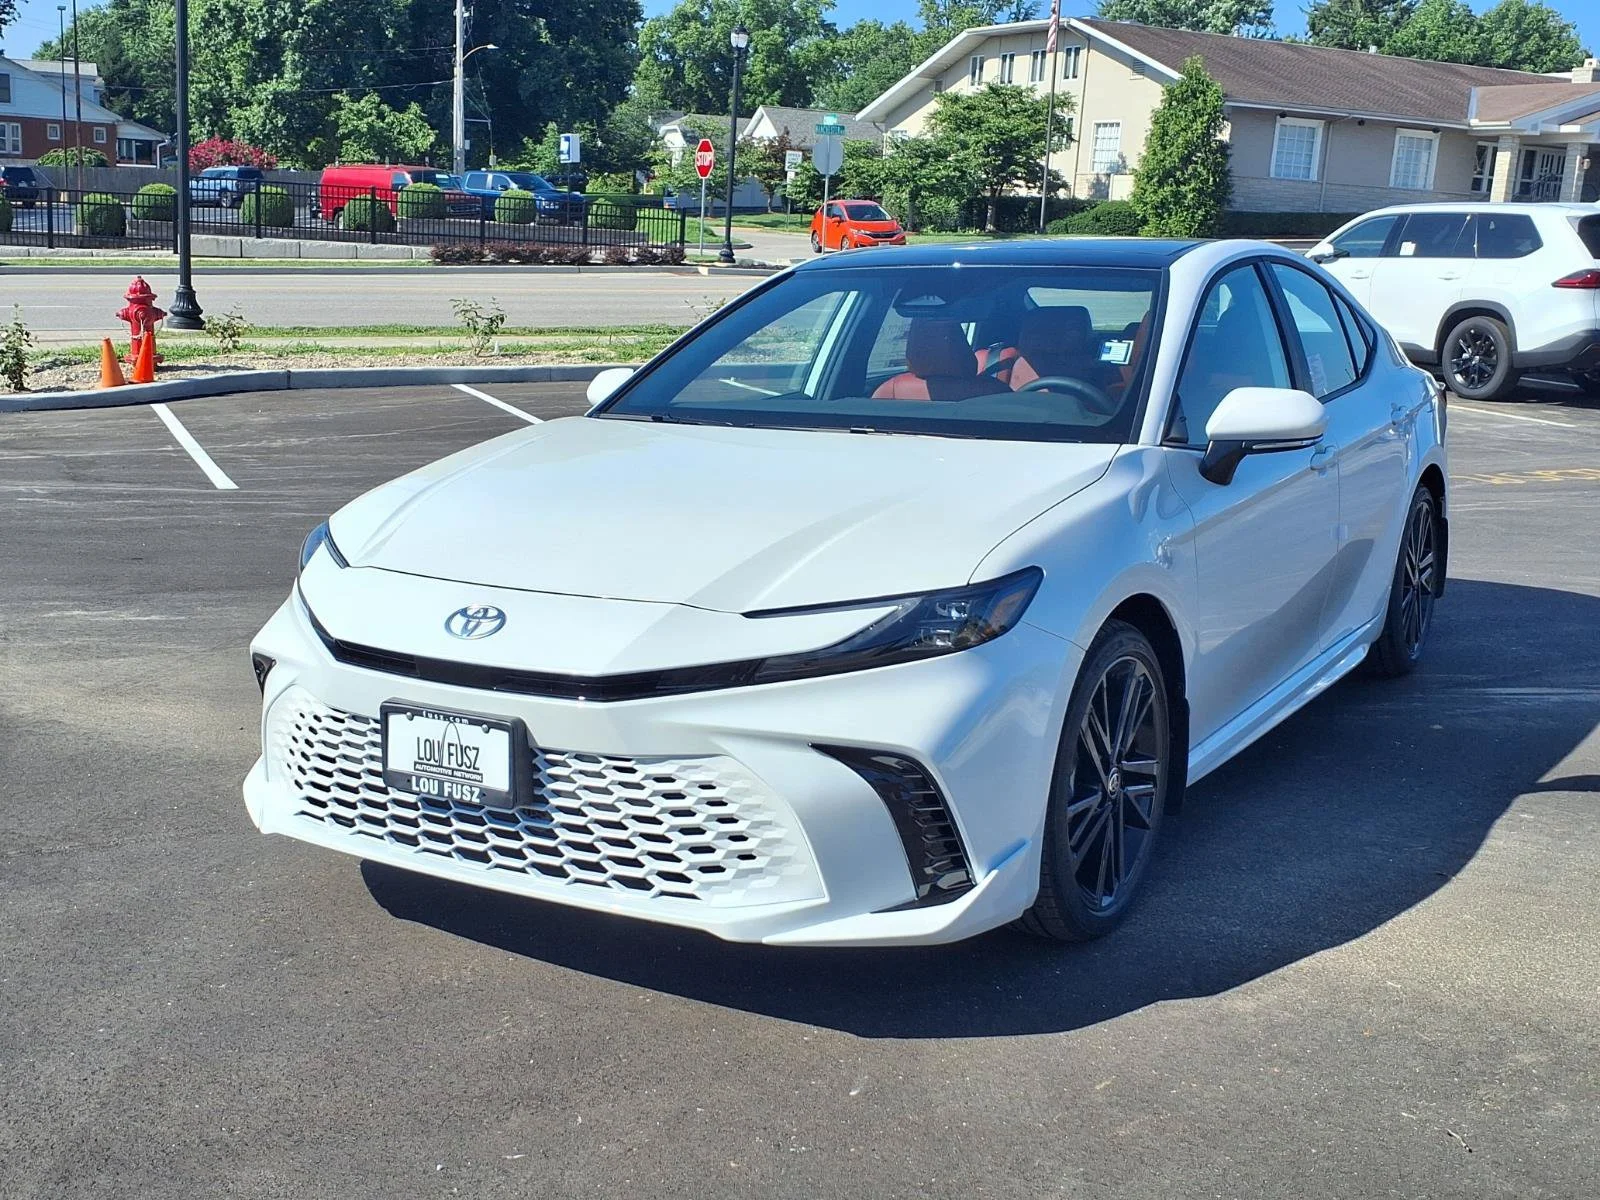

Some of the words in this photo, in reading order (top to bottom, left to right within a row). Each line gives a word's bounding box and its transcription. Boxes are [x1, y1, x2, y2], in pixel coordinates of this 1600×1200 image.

[696, 152, 714, 166] STOP
[423, 710, 469, 724] fusz.com
[417, 736, 440, 764] LOU
[447, 742, 479, 770] FUSZ
[415, 764, 452, 775] AUTOMOTIVE
[453, 771, 482, 781] NETWORK
[411, 776, 438, 795] LOU
[443, 781, 481, 803] FUSZ
